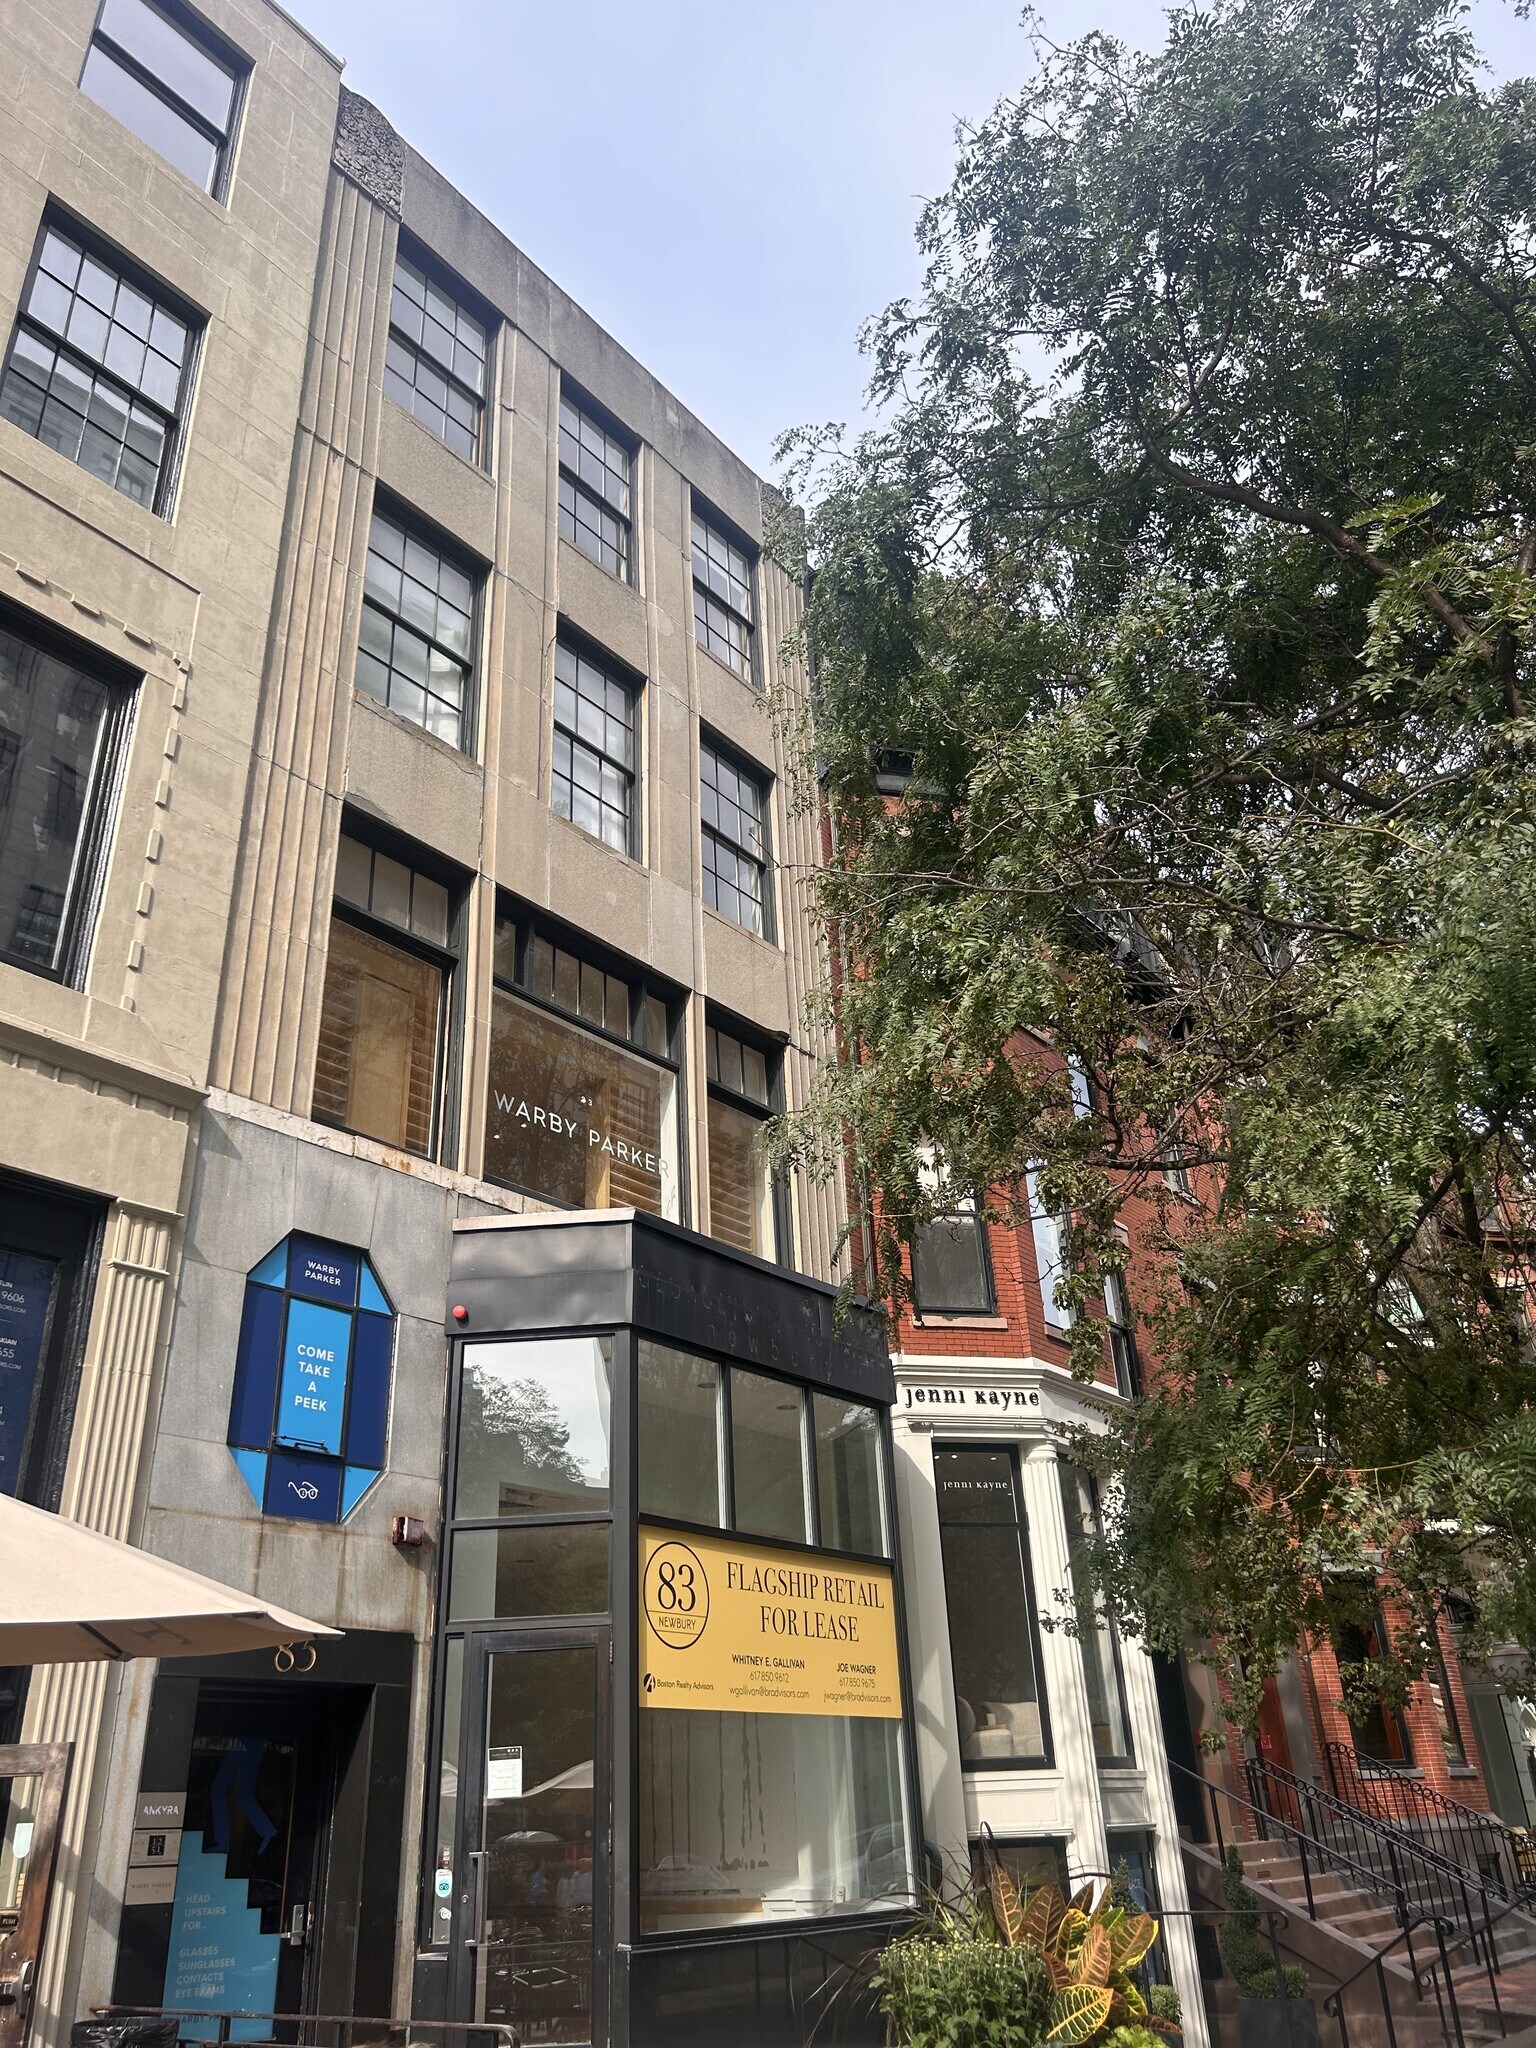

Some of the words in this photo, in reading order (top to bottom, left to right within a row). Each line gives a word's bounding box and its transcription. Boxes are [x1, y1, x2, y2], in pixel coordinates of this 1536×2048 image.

[493, 1089, 577, 1138] WARBY
[589, 1129, 670, 1179] PARKER
[307, 1260, 340, 1276] WARBY
[304, 1269, 341, 1286] PARKER
[1, 1290, 25, 1304] 9606
[297, 1344, 335, 1362] COME
[298, 1361, 331, 1378] TAKE
[307, 1381, 317, 1393] A
[294, 1395, 327, 1412] PEEK
[905, 1387, 966, 1408] jenni
[974, 1389, 1040, 1411] kayne
[943, 1480, 973, 1491] jenni
[976, 1481, 1008, 1491] kayne
[657, 1561, 697, 1612] 83
[726, 1561, 819, 1600] FLAGSHIP
[823, 1576, 885, 1609] RETAIL
[658, 1615, 697, 1631] NEWBURY
[760, 1605, 800, 1637] FOR
[804, 1610, 860, 1642] LEASE
[731, 1653, 764, 1666] WHITNEY
[765, 1656, 772, 1667] E.
[773, 1657, 805, 1669] GALLIVAN
[836, 1662, 849, 1673] JOE
[850, 1663, 877, 1675] WAGNER
[657, 1679, 675, 1688] Boston
[676, 1680, 692, 1691] Realty
[693, 1681, 714, 1691] Advisors
[143, 1805, 179, 1815] ANKYRA
[185, 1894, 211, 1903] HEAD
[184, 1906, 227, 1917] UPSTAIRS
[179, 1946, 219, 1957] GLASSES
[178, 1958, 236, 1971] SUNGLASSES
[176, 1972, 224, 1984] CONTACTS
[175, 1989, 192, 1998] EYE
[194, 1985, 225, 1997] EXAMS
